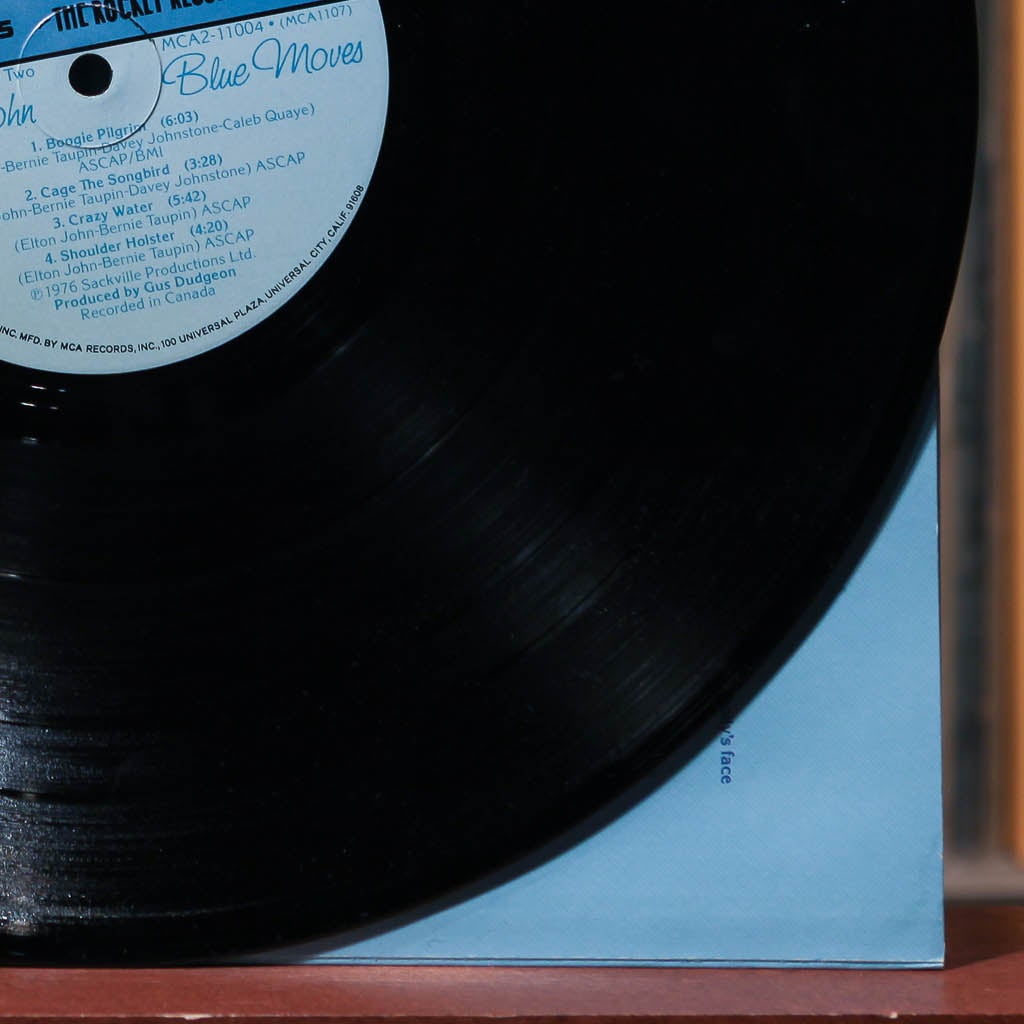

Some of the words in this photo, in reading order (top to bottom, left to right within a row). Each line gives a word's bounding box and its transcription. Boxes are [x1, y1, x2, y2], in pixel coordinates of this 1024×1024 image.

[51, 2, 88, 31] THE
[162, 21, 264, 51] MCA2-11004
[280, 4, 351, 29] (MCA1107)
[4, 67, 34, 80] Two
[158, 52, 250, 95] Blue
[251, 37, 363, 78] Moves
[31, 141, 41, 152] 1.
[45, 131, 93, 153] Boogie
[160, 110, 198, 128] (6:03)
[148, 113, 261, 147] Johnstone-Caleb
[264, 103, 314, 122] Quaye)
[24, 189, 36, 201] 2.
[40, 185, 79, 199] Cage
[79, 178, 103, 190] The
[107, 163, 169, 190] Songbird
[184, 153, 222, 174] (3:28)
[78, 146, 162, 172] ASCAP/BMI
[78, 181, 169, 205] Taupin-Davey
[175, 162, 251, 187] Johnstone)
[256, 151, 305, 171] ASCAP
[14, 236, 55, 252] (Elton
[60, 218, 142, 242] John-Bernie
[146, 206, 196, 226] Taupin)
[202, 196, 250, 215] ASCAP
[52, 217, 64, 229] 3.
[68, 211, 107, 229] Crazy
[112, 202, 152, 216] Water
[167, 190, 206, 207] (5:42)
[18, 269, 59, 284] (Elton
[64, 251, 145, 275] John-Bernie
[150, 239, 199, 258] Taupin)
[204, 228, 254, 248] ASCAP
[44, 252, 56, 264] 4.
[59, 242, 120, 261] Shoulder
[125, 232, 174, 248] Holster
[189, 220, 228, 236] (4:20)
[0, 325, 17, 339] INC.
[19, 332, 42, 346] MFD.
[44, 338, 58, 348] BY
[60, 342, 82, 352] MCA
[86, 344, 137, 353] RECORDS,
[138, 342, 160, 352] INC.,
[161, 338, 176, 348] 100
[179, 317, 233, 343] UNIVERSAL
[234, 298, 268, 319] PLAZA,
[265, 259, 312, 299] UNIVERSAL
[310, 237, 331, 258] CITY,
[327, 211, 350, 237] CALIF.
[346, 185, 364, 211] 91608
[54, 287, 119, 310] Produced
[123, 286, 143, 303] by
[143, 281, 170, 292] Gus
[174, 268, 236, 287] Dudgeon
[81, 269, 141, 291] Sackville
[144, 255, 226, 278] Productions
[229, 247, 255, 262] Ltd.
[80, 297, 144, 320] Recorded
[148, 296, 160, 307] in
[164, 282, 215, 303] Canada
[720, 751, 734, 784] face
